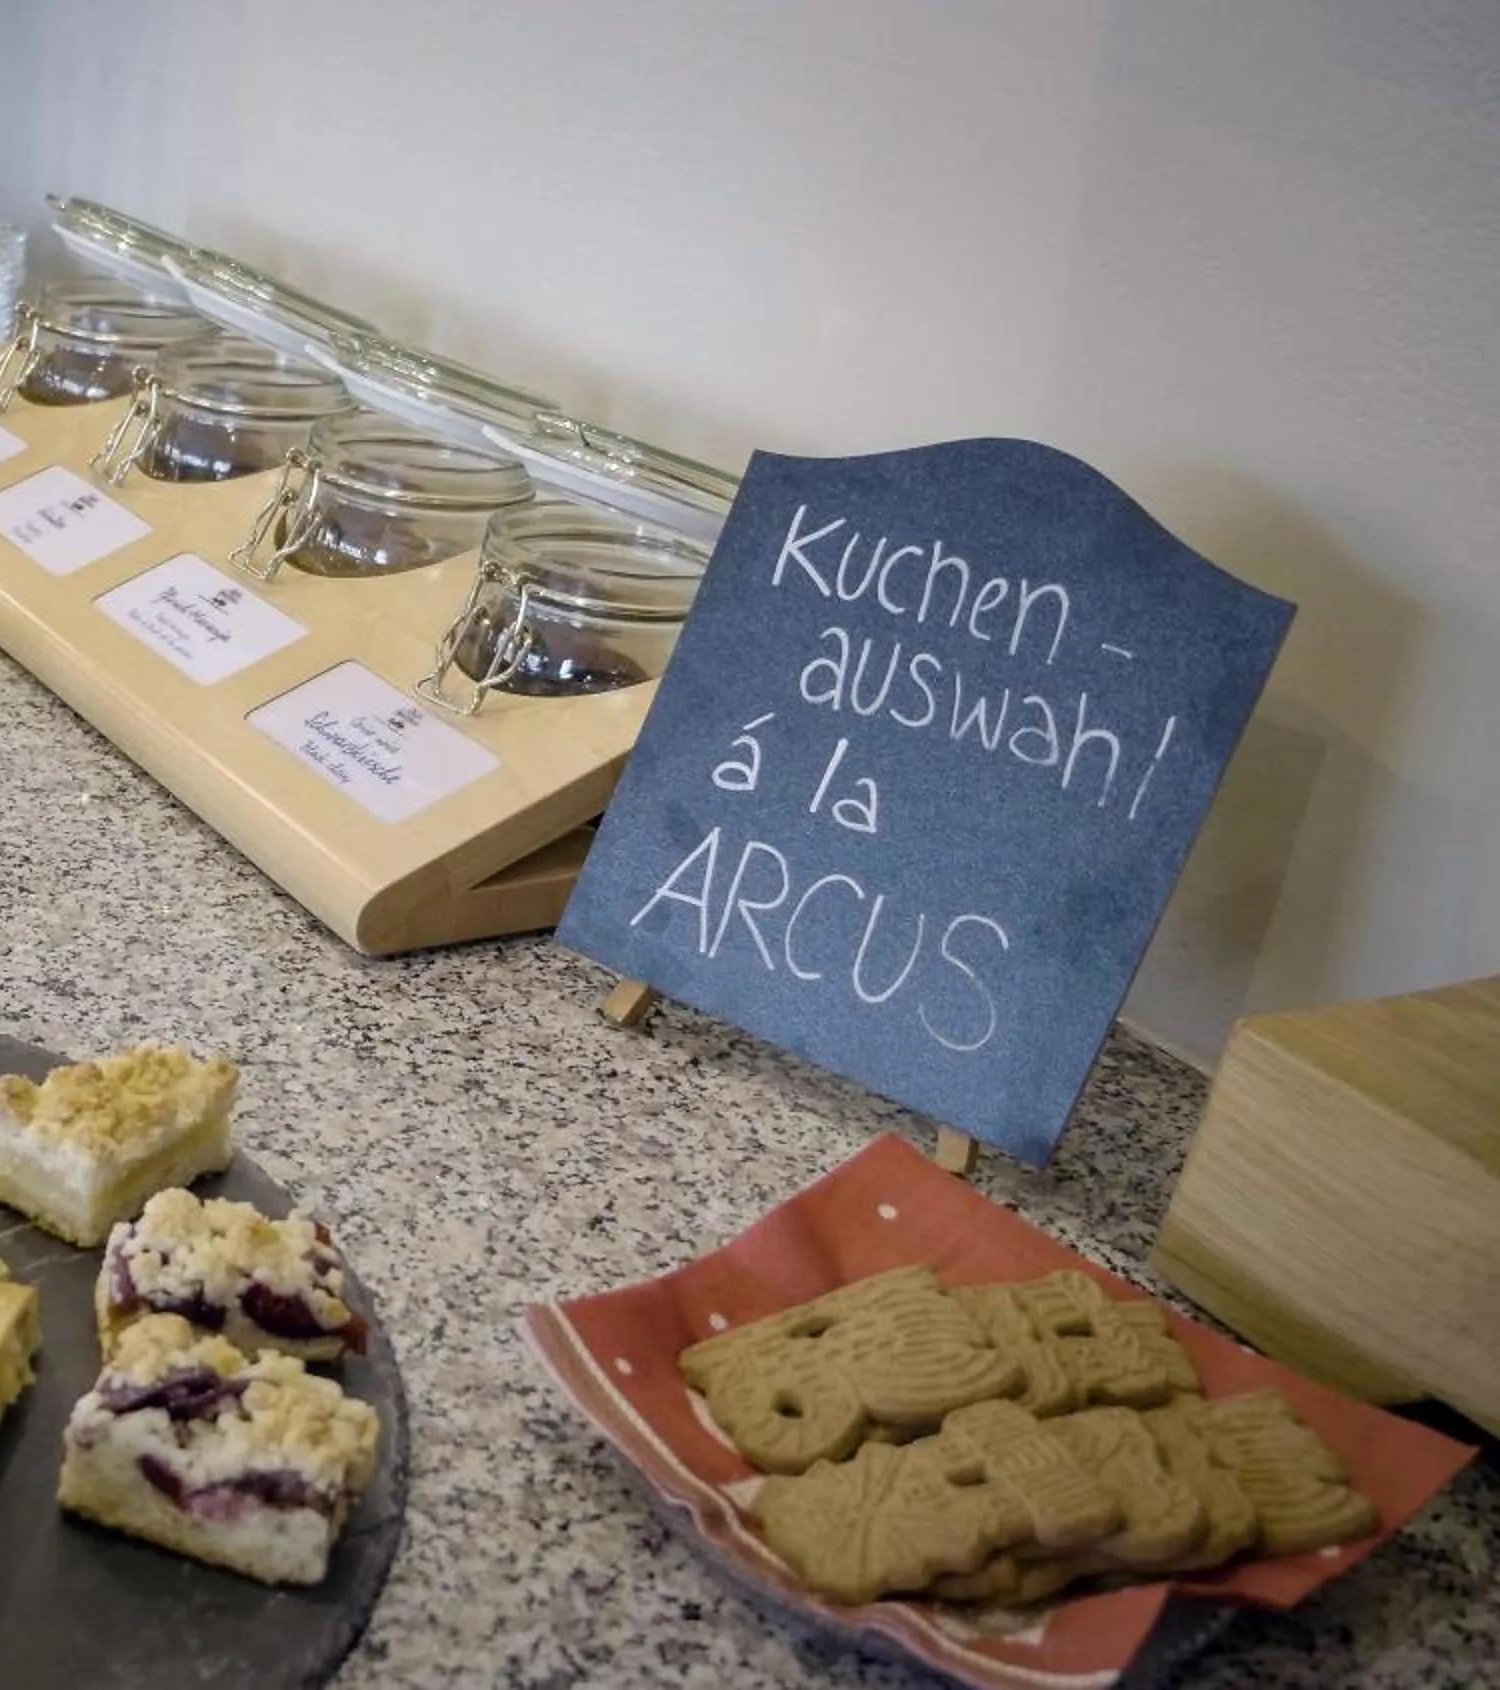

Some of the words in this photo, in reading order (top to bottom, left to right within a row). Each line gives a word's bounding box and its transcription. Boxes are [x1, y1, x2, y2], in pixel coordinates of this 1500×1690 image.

[711, 711, 776, 791] á
[809, 737, 878, 834] la
[799, 626, 1177, 820] auswahl
[629, 825, 1011, 1052] ARCUS
